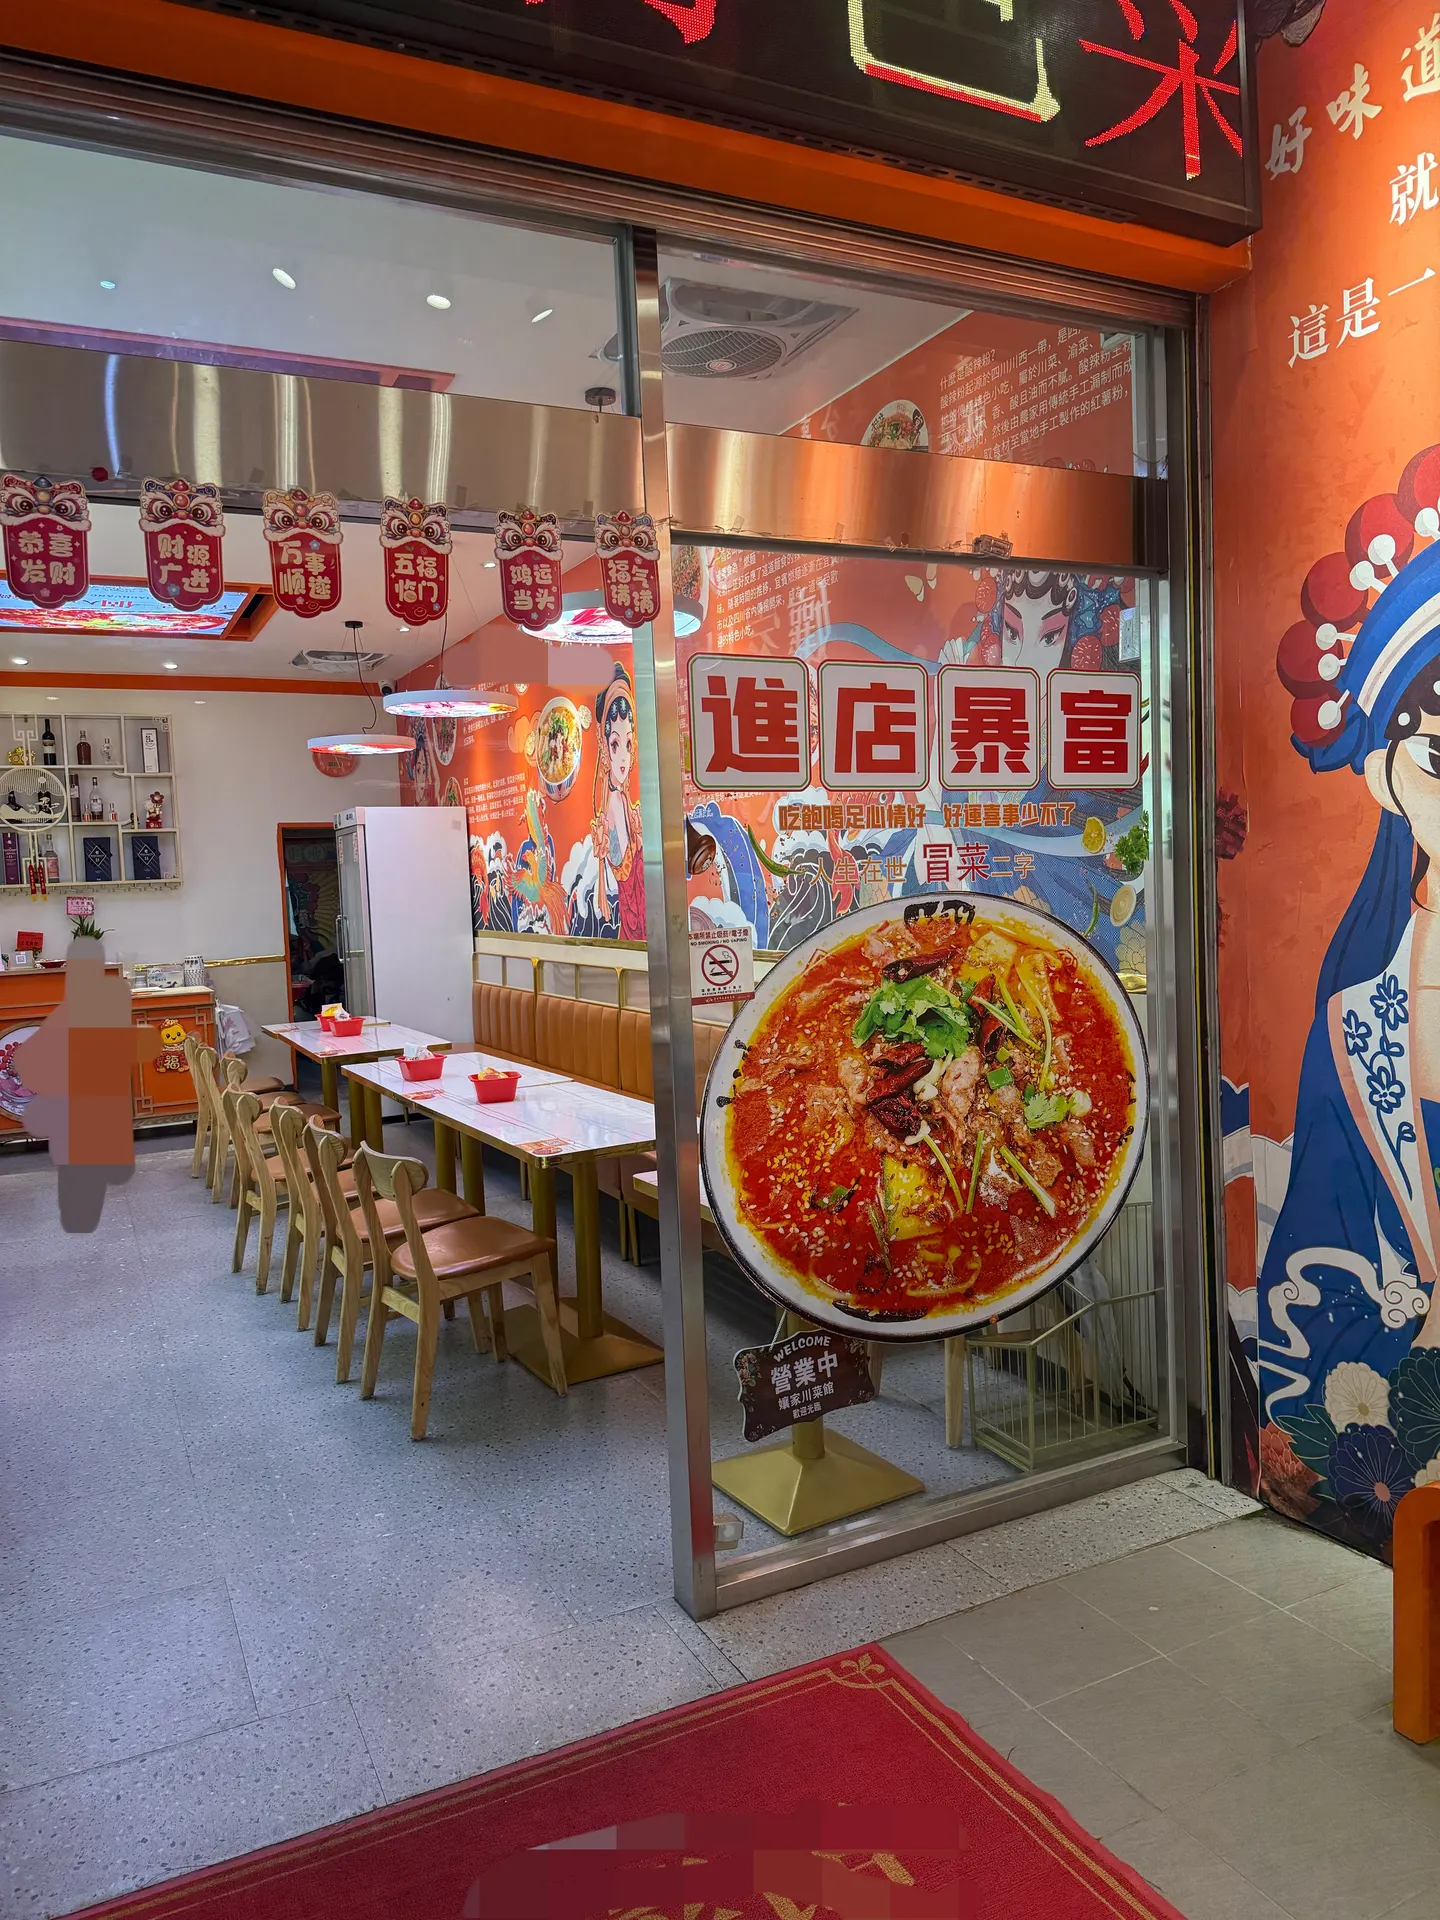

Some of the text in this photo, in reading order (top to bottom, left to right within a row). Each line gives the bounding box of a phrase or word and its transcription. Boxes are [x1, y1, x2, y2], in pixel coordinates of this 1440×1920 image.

[1389, 151, 1439, 226] 就
[1287, 267, 1436, 369] 這是一
[18, 530, 74, 557] 恭喜
[157, 533, 212, 566] 财源
[279, 541, 327, 575] 万事
[20, 559, 76, 586] 发财
[159, 562, 210, 593] 广进
[394, 552, 438, 578] 五福
[510, 563, 553, 586] 鸿运
[607, 559, 650, 589] 福气
[279, 568, 331, 600] 顺遂
[394, 579, 439, 603] 临门
[512, 588, 555, 610] 当头
[611, 583, 654, 614] 满满
[702, 675, 1133, 773] 進店暴富
[778, 802, 1076, 831] 吃飽喝足心情好 好運喜事少不了
[810, 855, 907, 886] 人生在世
[164, 1055, 180, 1070] 福
[773, 1335, 832, 1362] WELCOME
[770, 1350, 838, 1395] 營業中
[792, 1401, 822, 1419] 歡迎光臨
